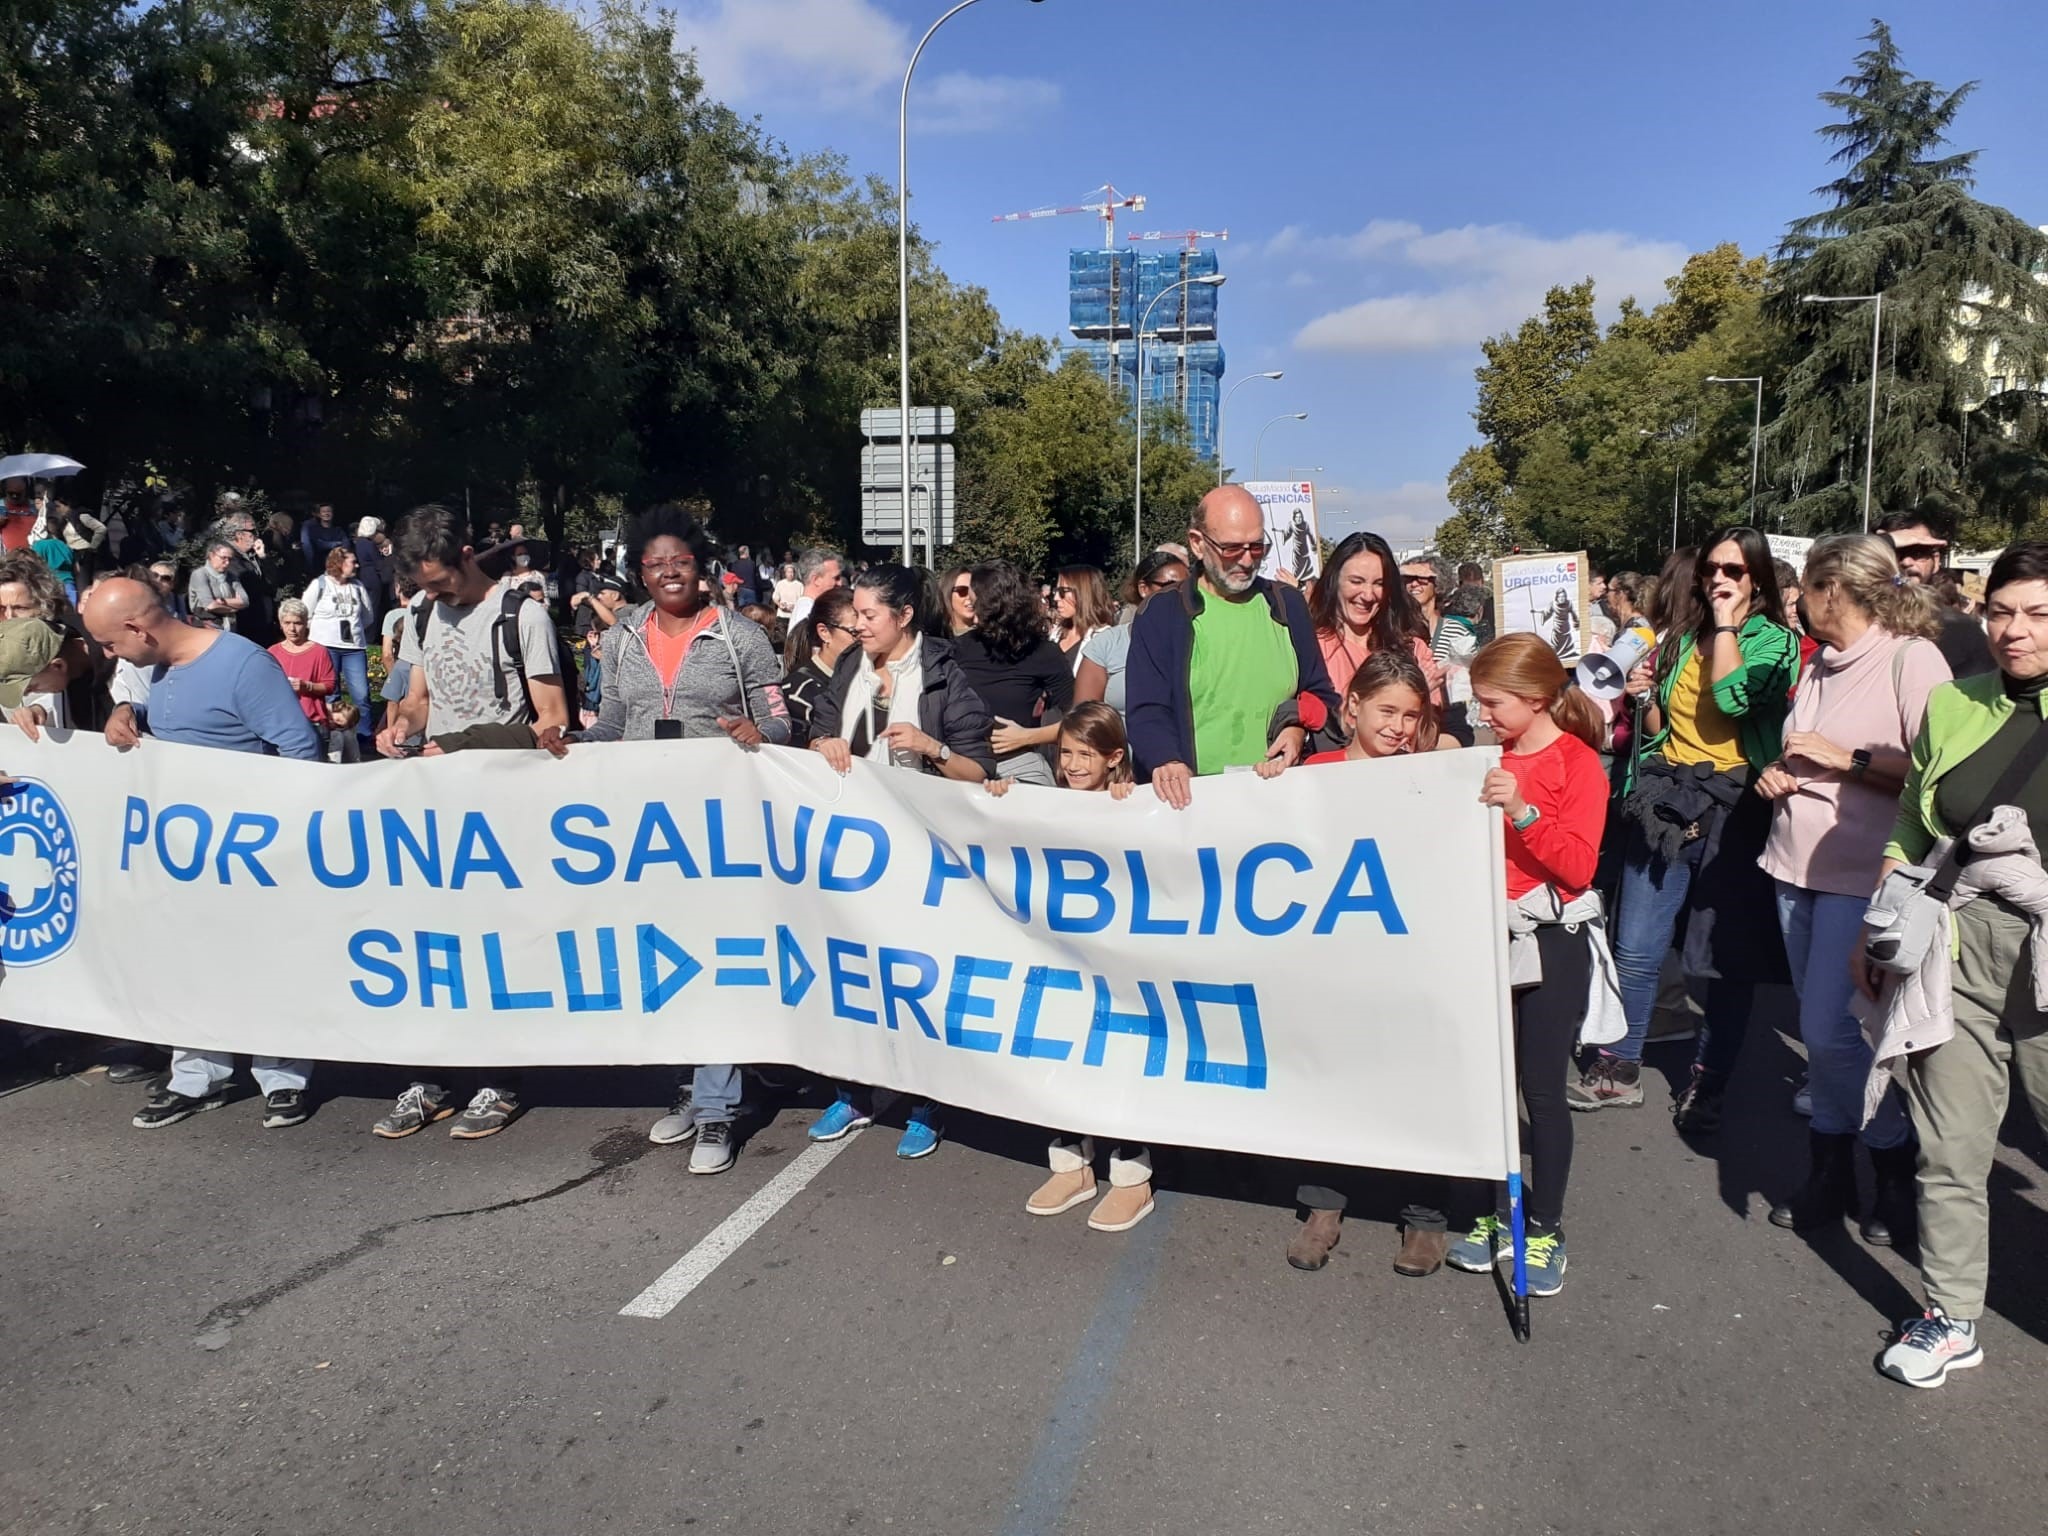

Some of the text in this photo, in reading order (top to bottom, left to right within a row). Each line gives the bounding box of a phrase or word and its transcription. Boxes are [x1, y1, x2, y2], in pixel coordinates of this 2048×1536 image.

[1255, 494, 1311, 504] RGENCIAS
[1504, 573, 1577, 588] URGENCIAS
[0, 793, 66, 846] DICOS
[121, 796, 1408, 937] POR UNA SALUD PUBLICA
